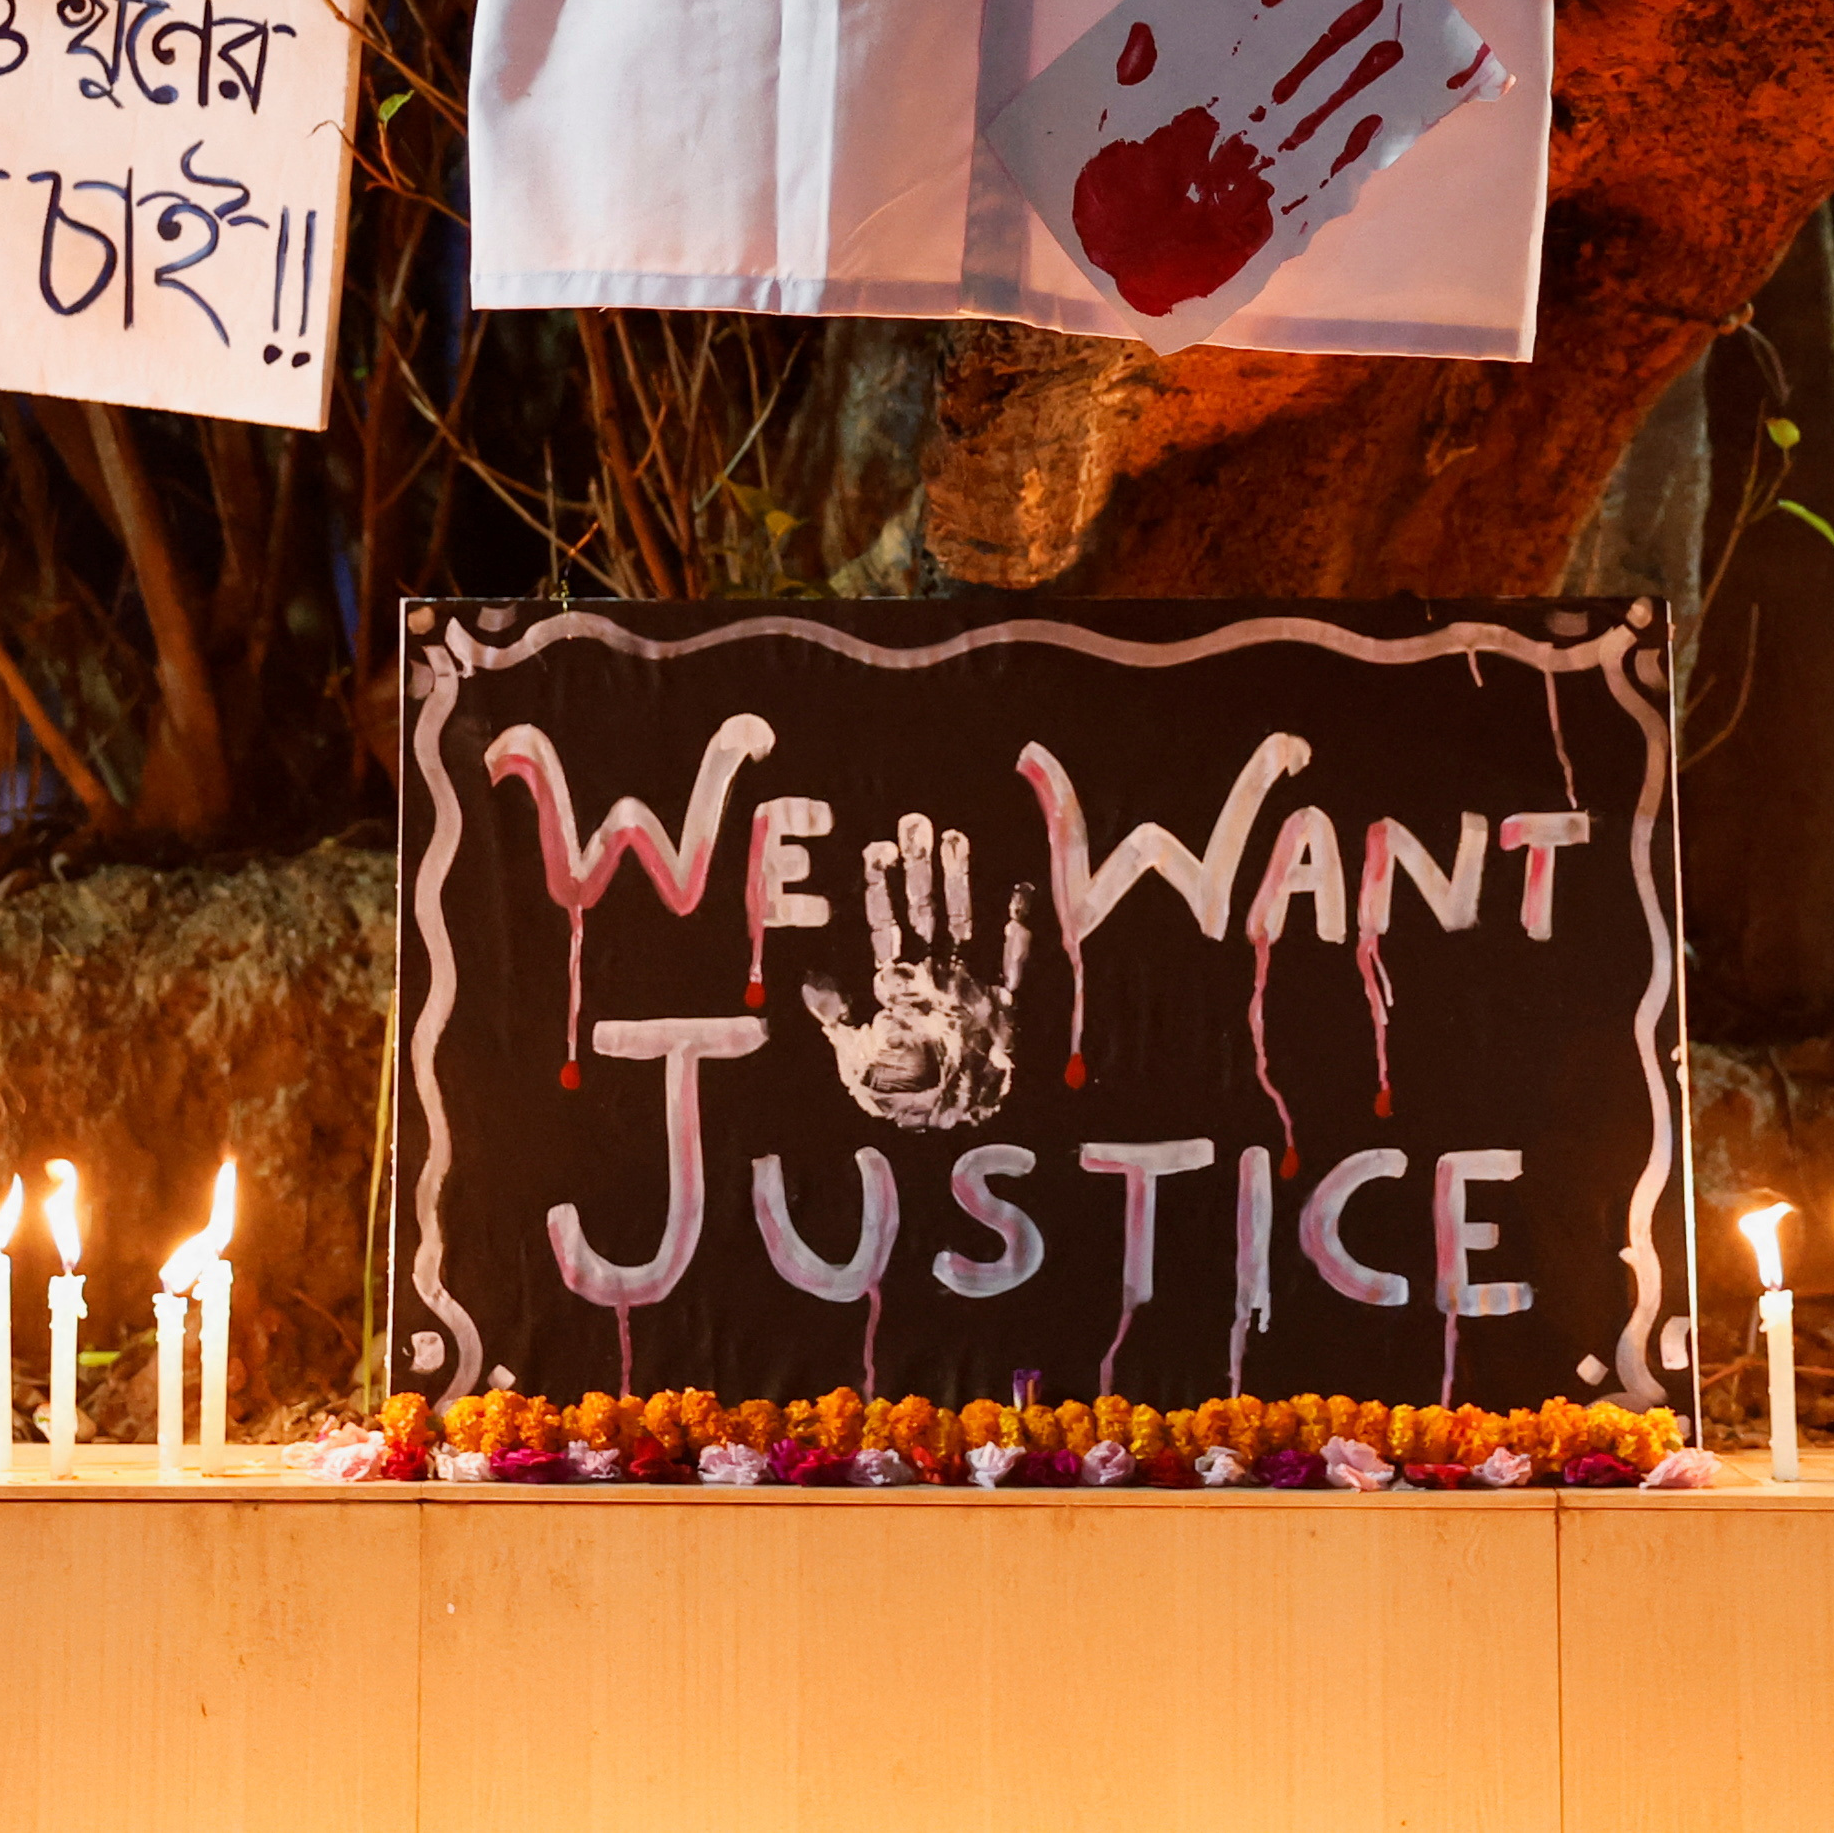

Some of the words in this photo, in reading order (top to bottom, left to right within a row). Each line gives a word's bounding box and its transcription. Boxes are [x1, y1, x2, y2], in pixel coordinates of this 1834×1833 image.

[483, 711, 835, 931] WE
[1016, 731, 1590, 946] WANT
[545, 1014, 1535, 1321] JUSTICE
